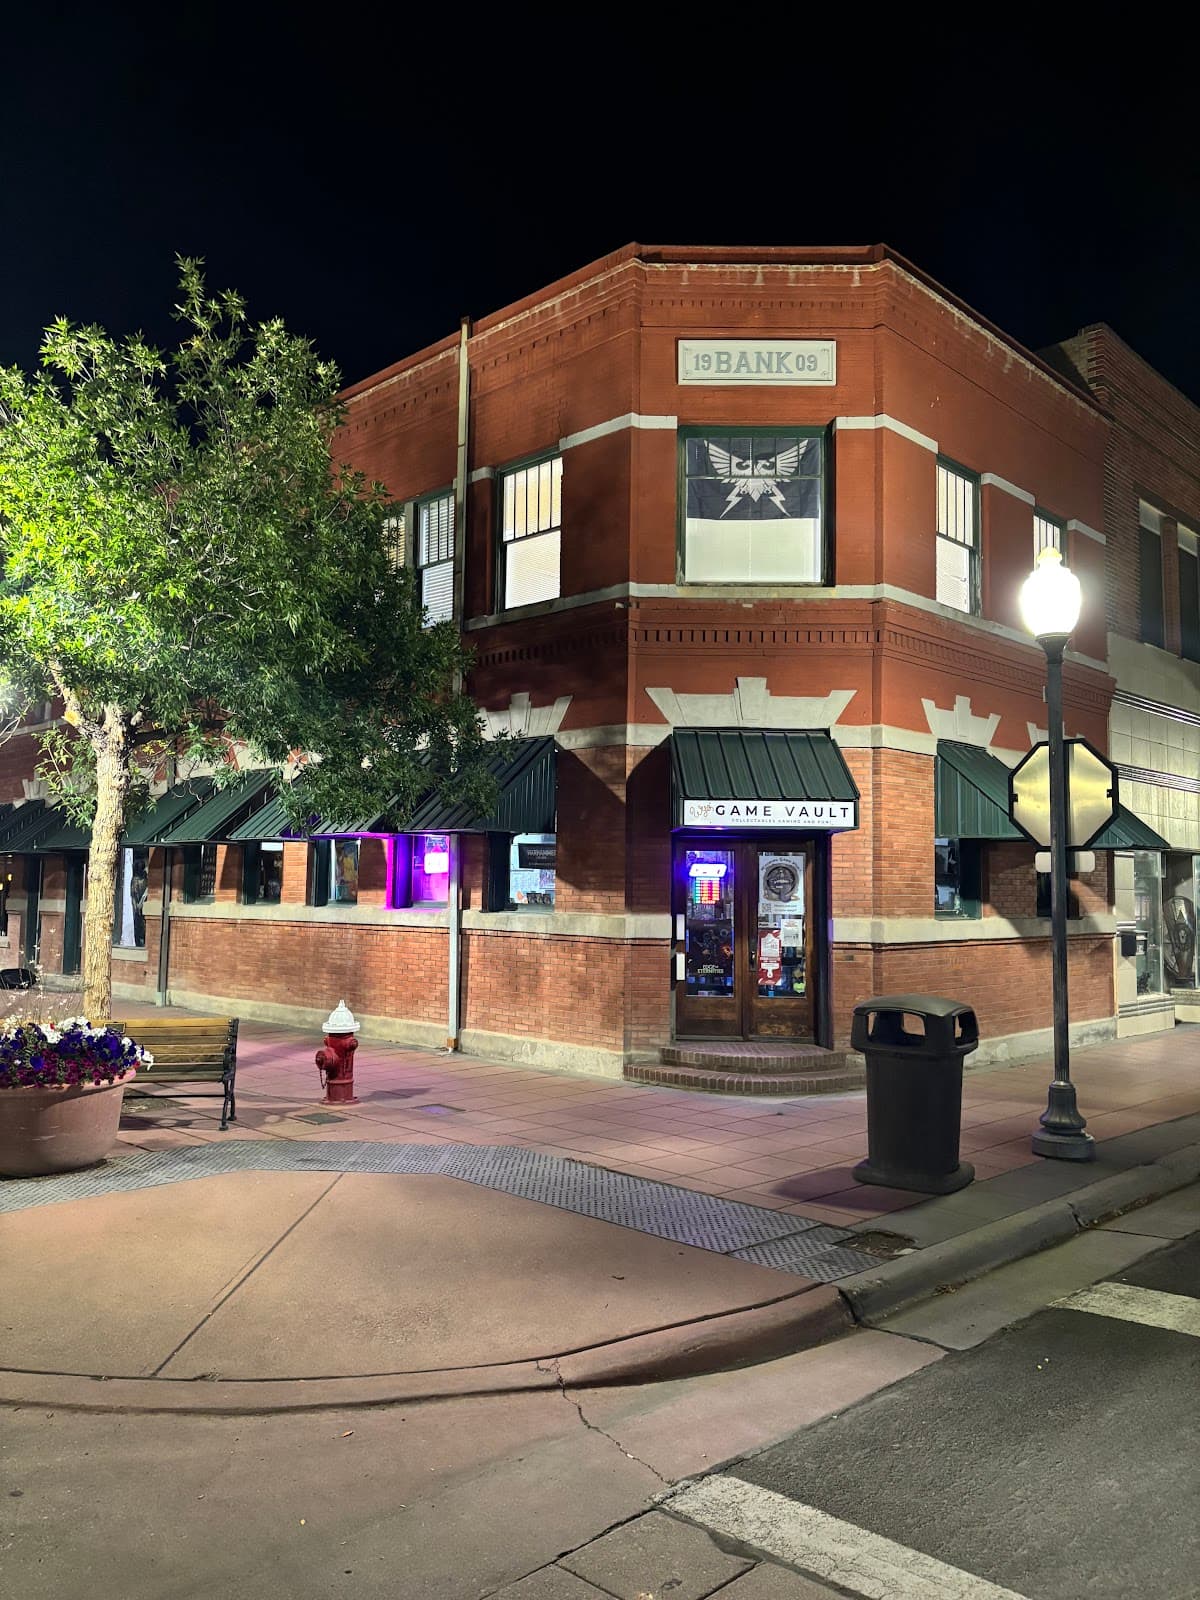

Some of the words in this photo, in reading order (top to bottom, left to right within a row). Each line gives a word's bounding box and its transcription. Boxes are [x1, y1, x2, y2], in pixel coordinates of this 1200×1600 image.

[695, 353, 712, 371] 19
[715, 352, 793, 373] BANK
[796, 355, 817, 371] 09
[715, 804, 772, 817] GAME
[785, 806, 849, 818] VAULT
